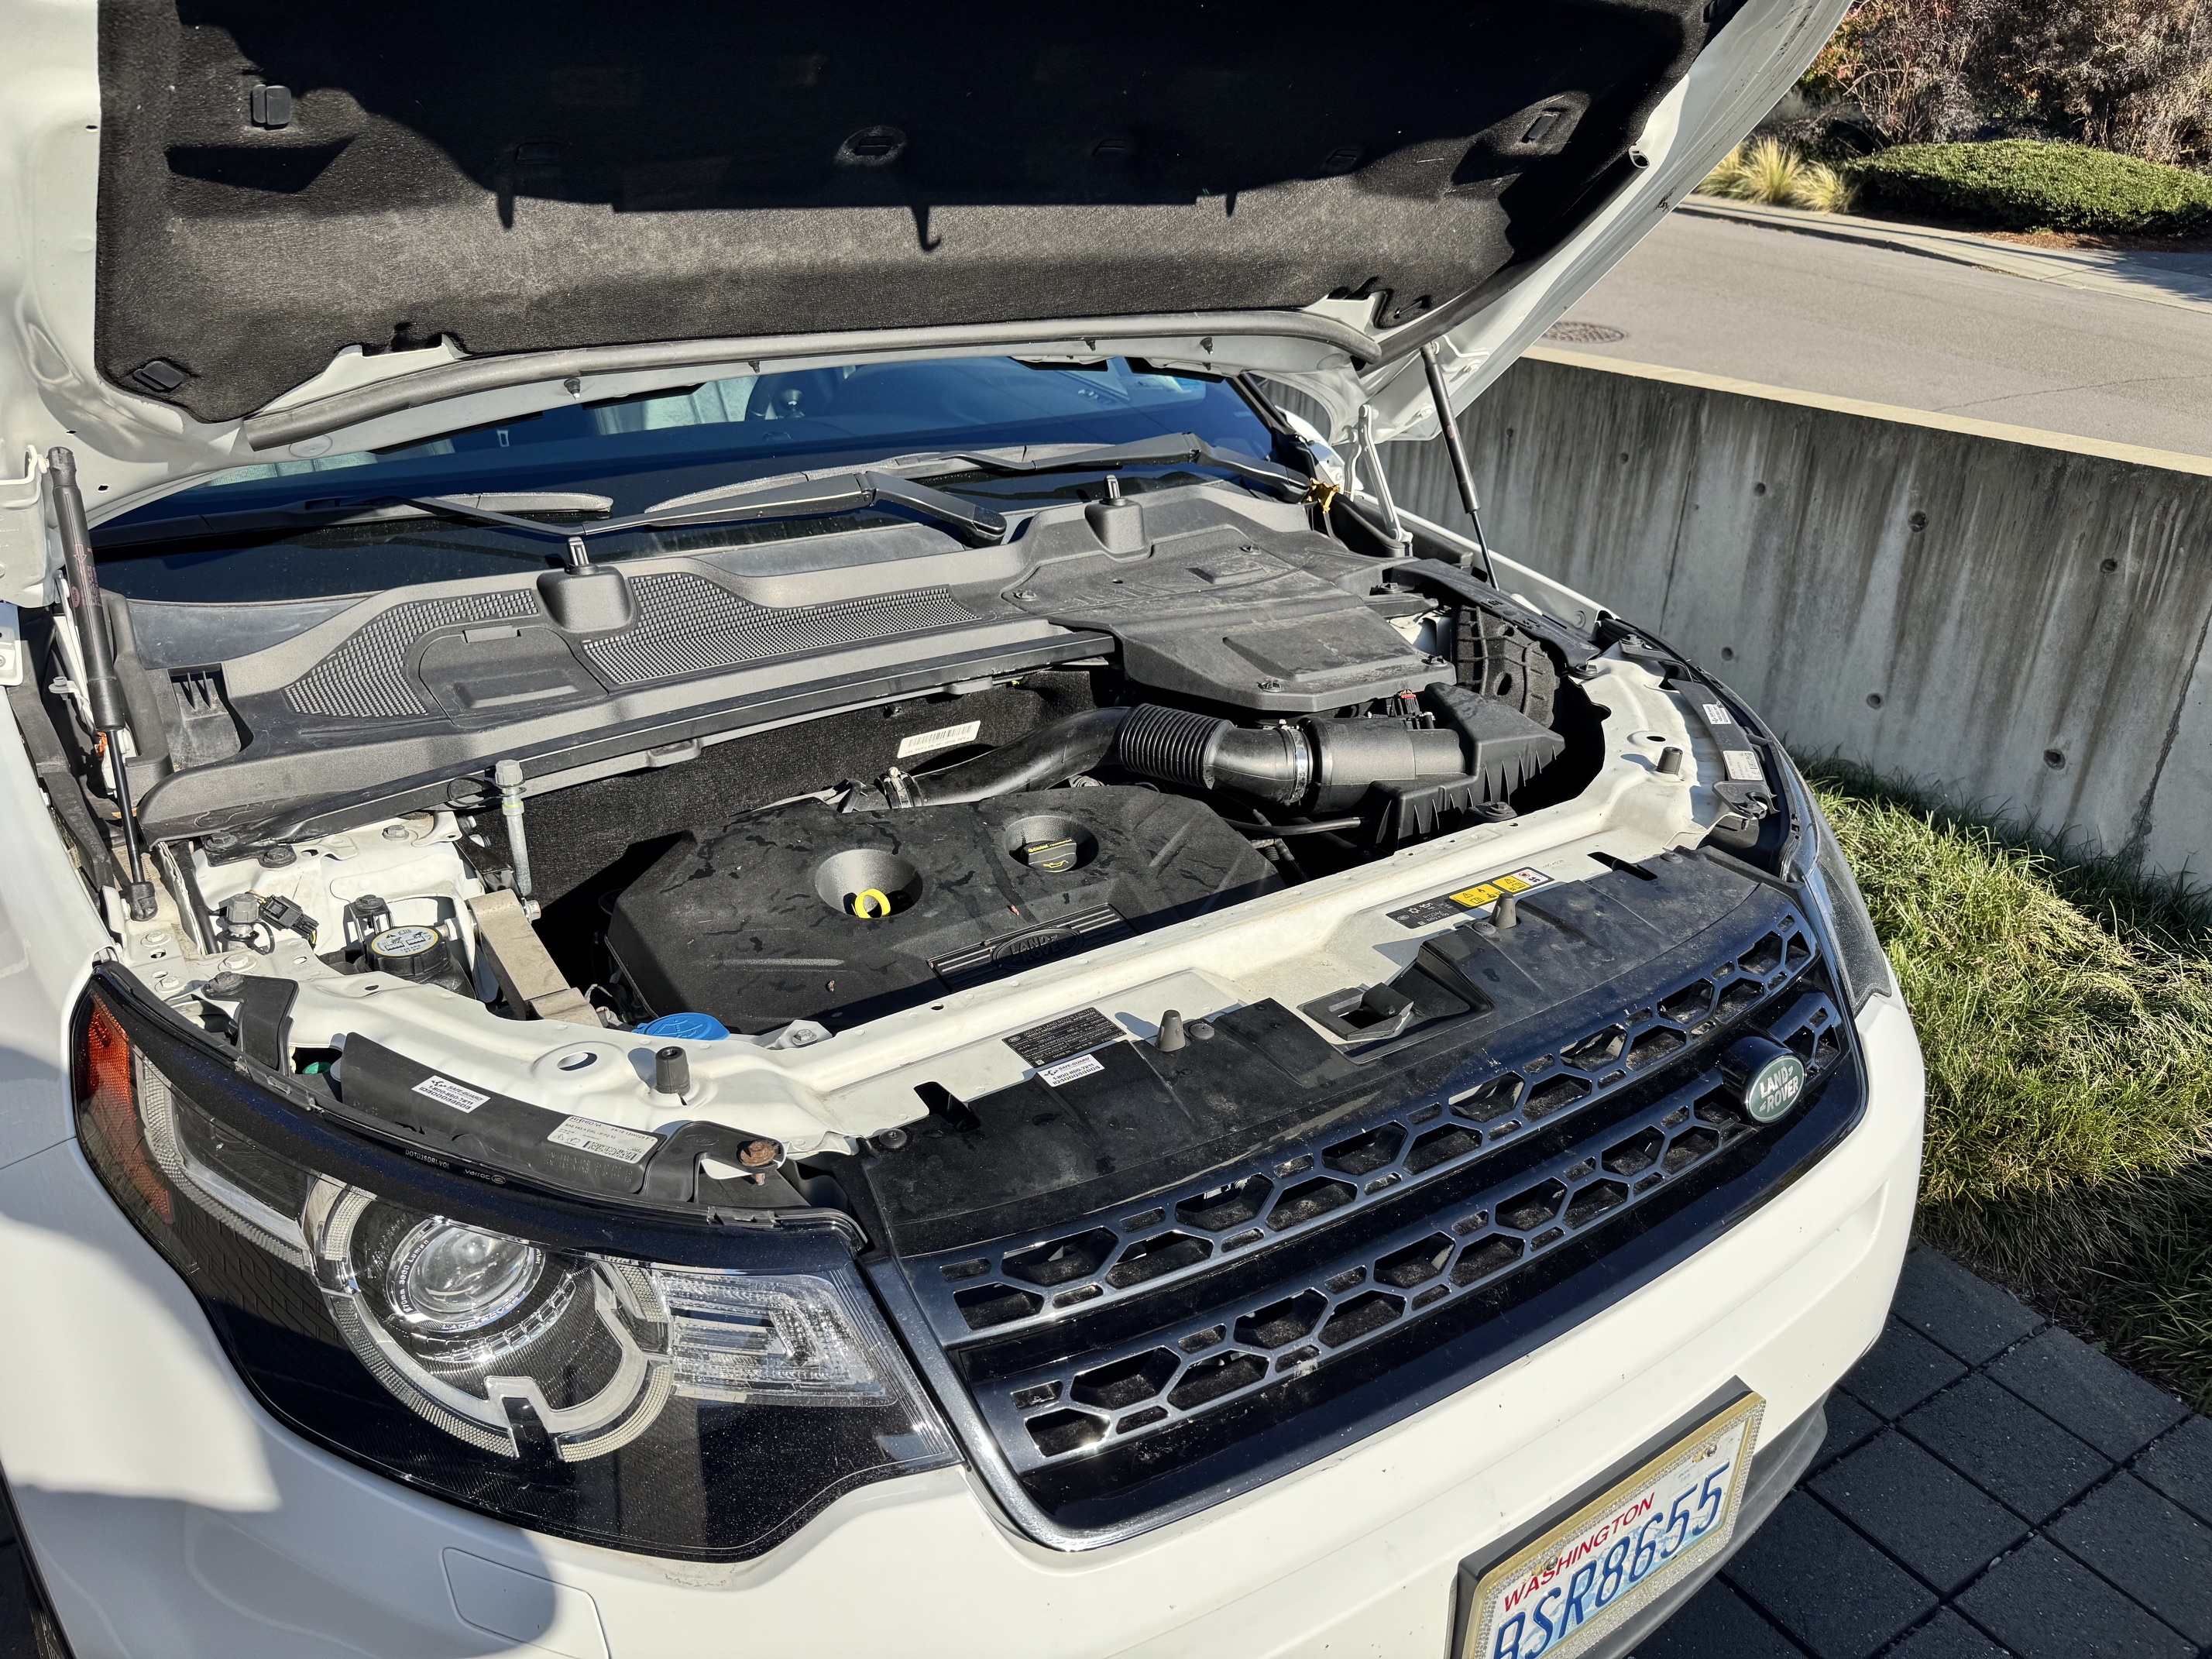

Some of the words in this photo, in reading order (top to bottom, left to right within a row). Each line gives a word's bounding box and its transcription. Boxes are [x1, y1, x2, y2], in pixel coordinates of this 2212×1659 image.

[1009, 935, 1049, 955] LAND
[1022, 939, 1069, 962] ROVER
[1023, 1027, 1043, 1036] JAGUAR
[1760, 1066, 1788, 1098] LAND
[1767, 1075, 1799, 1112] ROVER
[399, 1264, 410, 1285] 3000
[407, 1239, 430, 1263] Lumen
[1504, 1492, 1655, 1612] WASHINGTON
